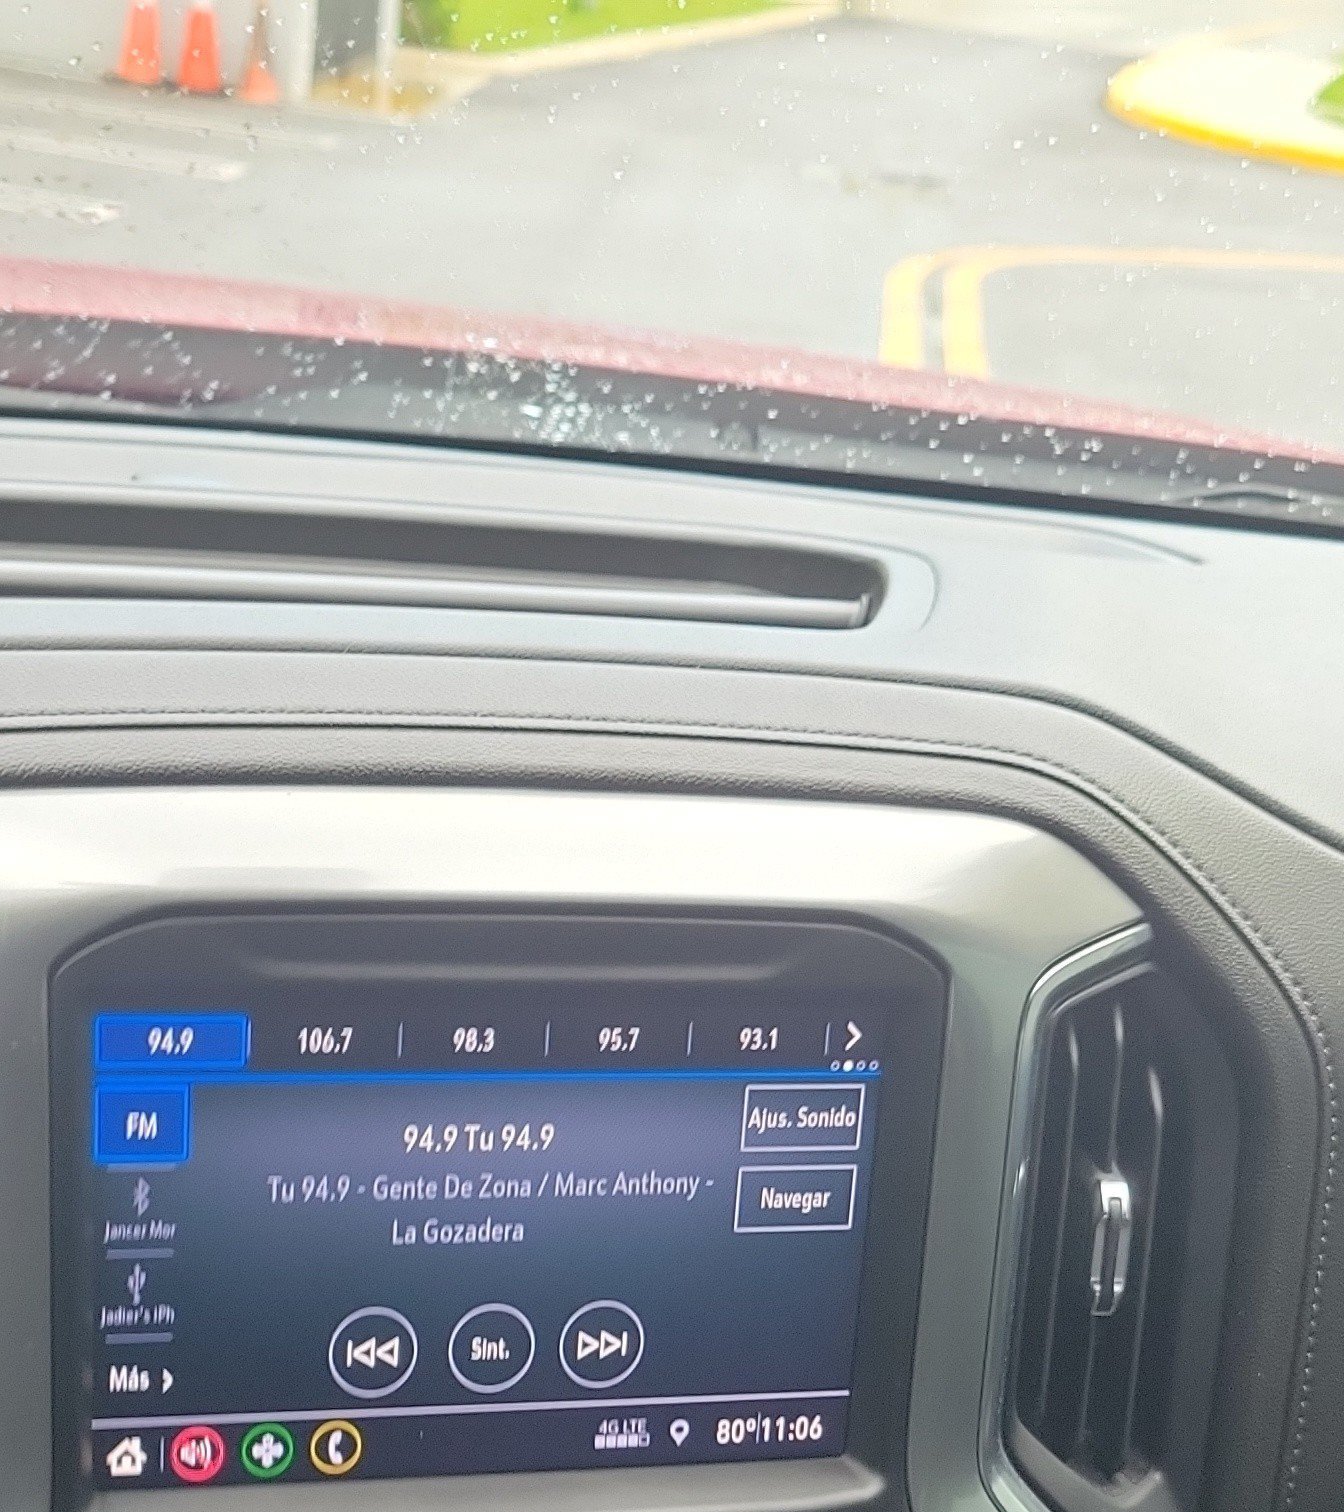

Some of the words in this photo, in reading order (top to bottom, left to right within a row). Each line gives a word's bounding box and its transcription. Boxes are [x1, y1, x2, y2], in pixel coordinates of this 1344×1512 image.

[147, 1026, 194, 1056] 94.9
[298, 1026, 354, 1055] 106.7
[453, 1027, 496, 1053] 98.3
[598, 1026, 641, 1052] 95.7
[739, 1026, 779, 1051] 93.1
[125, 1111, 158, 1141] FM
[747, 1106, 793, 1135] Ajus.
[795, 1104, 857, 1129] Sonido
[403, 1123, 459, 1154] 94.9
[463, 1123, 495, 1153] Tu
[501, 1122, 555, 1152] 94.9
[266, 1174, 296, 1204] Tu
[302, 1174, 351, 1203] 94.9
[372, 1174, 438, 1202] Gente
[444, 1172, 474, 1200] De
[478, 1171, 533, 1199] Zona
[554, 1170, 607, 1198] Marc
[612, 1168, 701, 1201] Anthony
[760, 1186, 831, 1214] Navegar
[391, 1217, 417, 1246] La
[422, 1215, 525, 1245] Gozadera
[470, 1335, 510, 1361] Sint.
[109, 1363, 150, 1394] Más
[598, 1418, 619, 1434] 4G
[622, 1416, 648, 1433] LTE
[760, 1414, 823, 1443] 11:06
